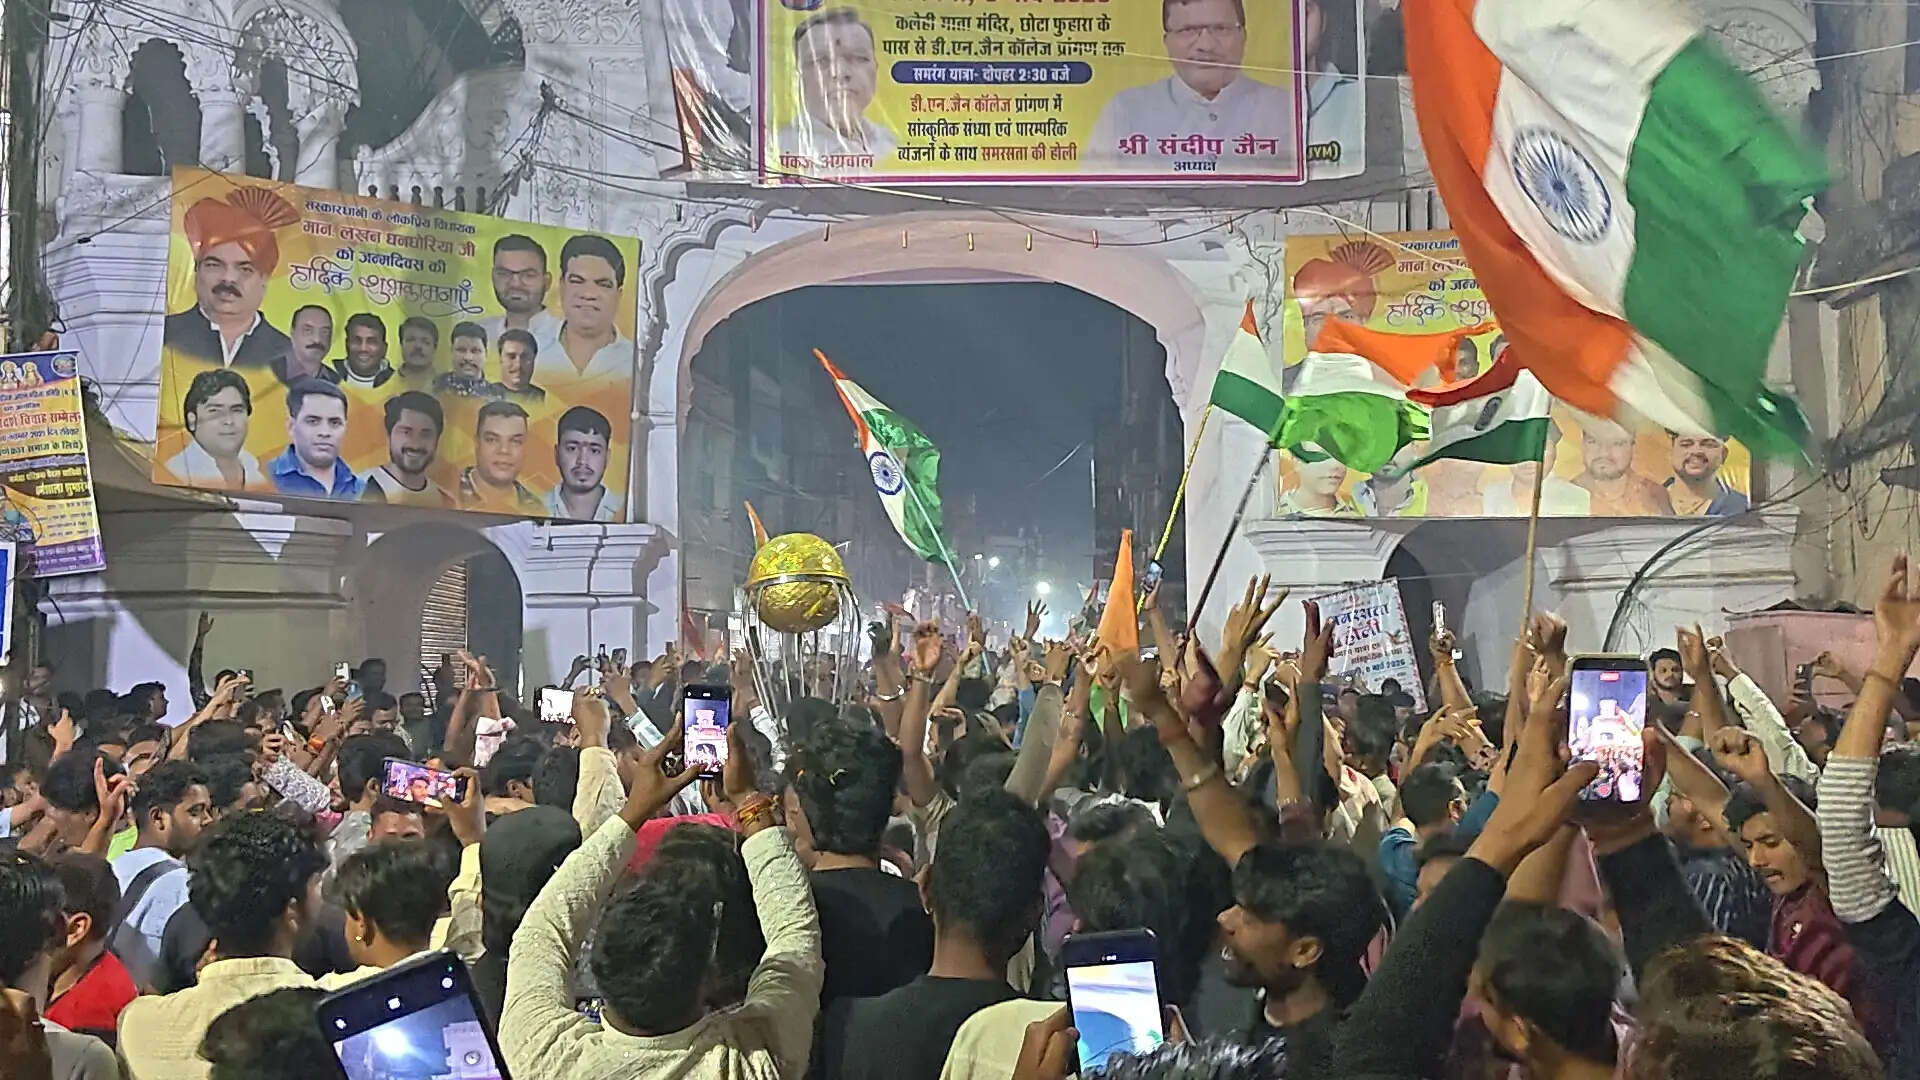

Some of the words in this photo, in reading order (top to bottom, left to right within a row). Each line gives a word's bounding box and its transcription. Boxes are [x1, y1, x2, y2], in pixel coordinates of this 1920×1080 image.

[976, 13, 1014, 35] मंदिर,
[1020, 13, 1049, 32] छोटा
[1053, 16, 1092, 36] फुहारा
[1099, 13, 1111, 32] के
[883, 40, 910, 55] पास
[914, 36, 926, 54] से
[1008, 37, 1051, 56] कॉलेज
[1102, 41, 1126, 56] तक
[983, 65, 1015, 82] दोपहर
[1018, 68, 1047, 82] 2:30
[1051, 65, 1070, 82] बजे
[974, 93, 1011, 113] कॉलेज
[1015, 93, 1049, 113] प्रांगण
[1053, 94, 1063, 112] में
[907, 118, 959, 141] सांस्कृतिक
[963, 118, 991, 137] संध्या
[995, 118, 1011, 137] एवं
[1016, 118, 1068, 137] पारम्परिक
[939, 143, 951, 161] के
[954, 147, 977, 161] साथ
[981, 147, 1028, 161] समरसता
[1032, 143, 1046, 161] की
[1050, 143, 1077, 161] होली
[1118, 134, 1149, 155] श्री
[1157, 133, 1224, 158] संदीप
[1232, 133, 1279, 155] जैन
[340, 225, 381, 244] लखन
[458, 241, 476, 258] जी
[336, 246, 354, 262] को
[359, 251, 424, 272] जन्मदिवस
[428, 258, 447, 274] की
[1429, 278, 1445, 291] को
[1450, 279, 1481, 290] जन्म
